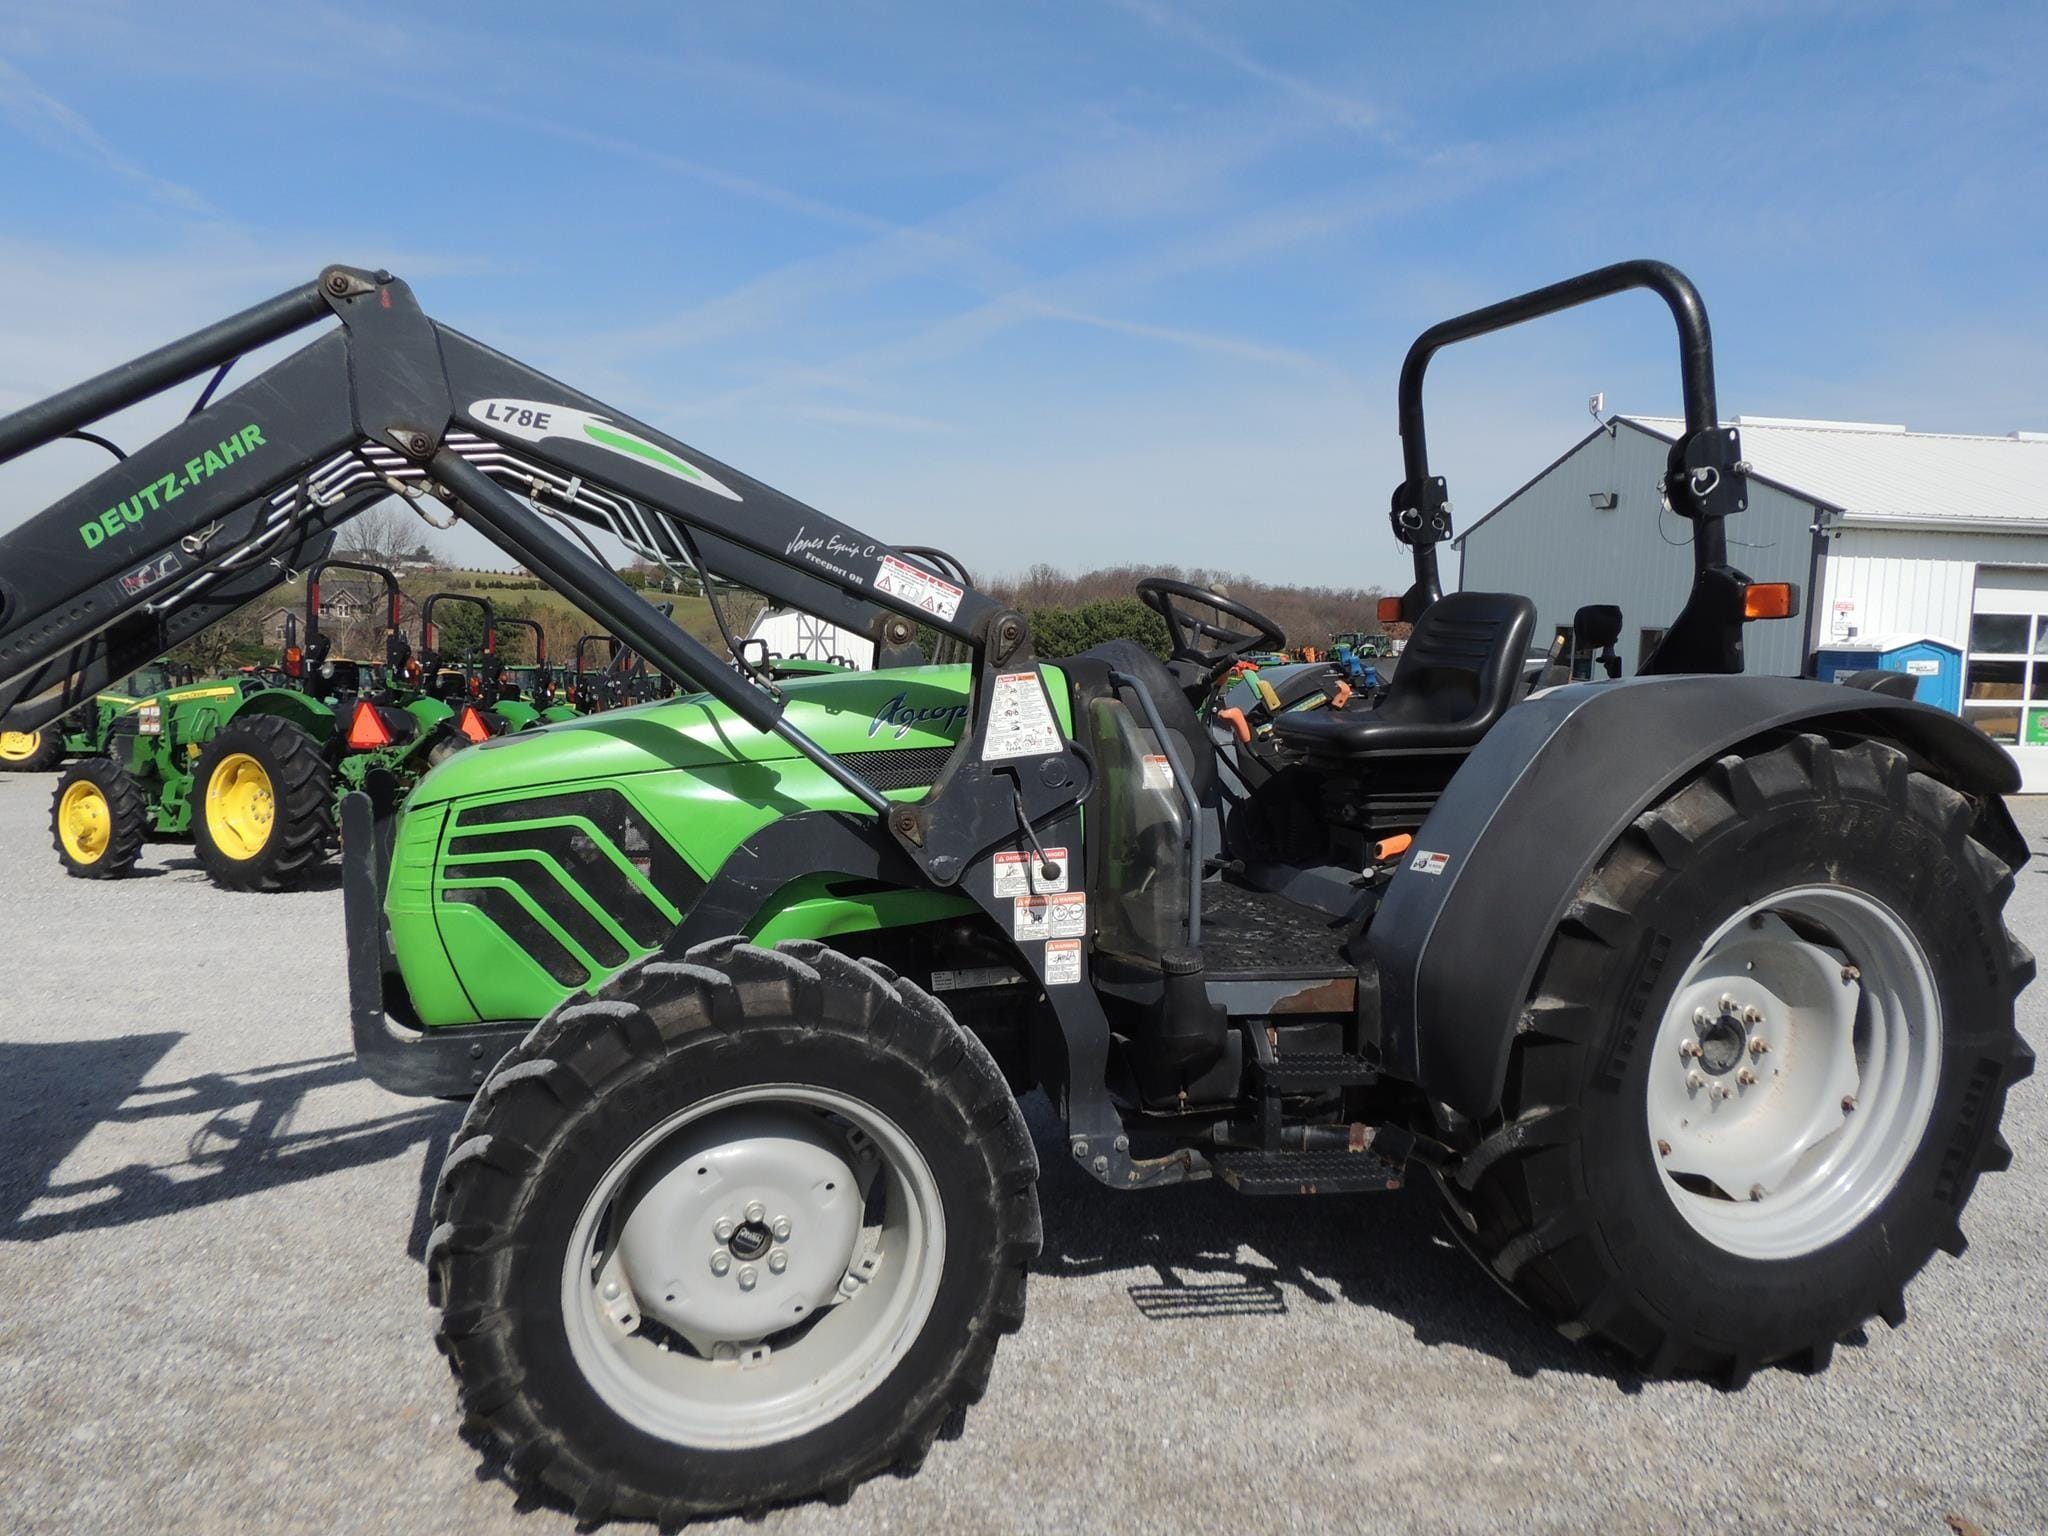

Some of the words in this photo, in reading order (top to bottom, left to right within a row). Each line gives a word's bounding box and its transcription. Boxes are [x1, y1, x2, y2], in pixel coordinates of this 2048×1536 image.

[485, 403, 551, 430] L78E
[79, 423, 267, 549] DEUTZ-FAHR
[785, 525, 823, 555] Jones
[826, 533, 860, 558] Equip
[805, 552, 847, 577] Freeport
[848, 572, 864, 585] OH
